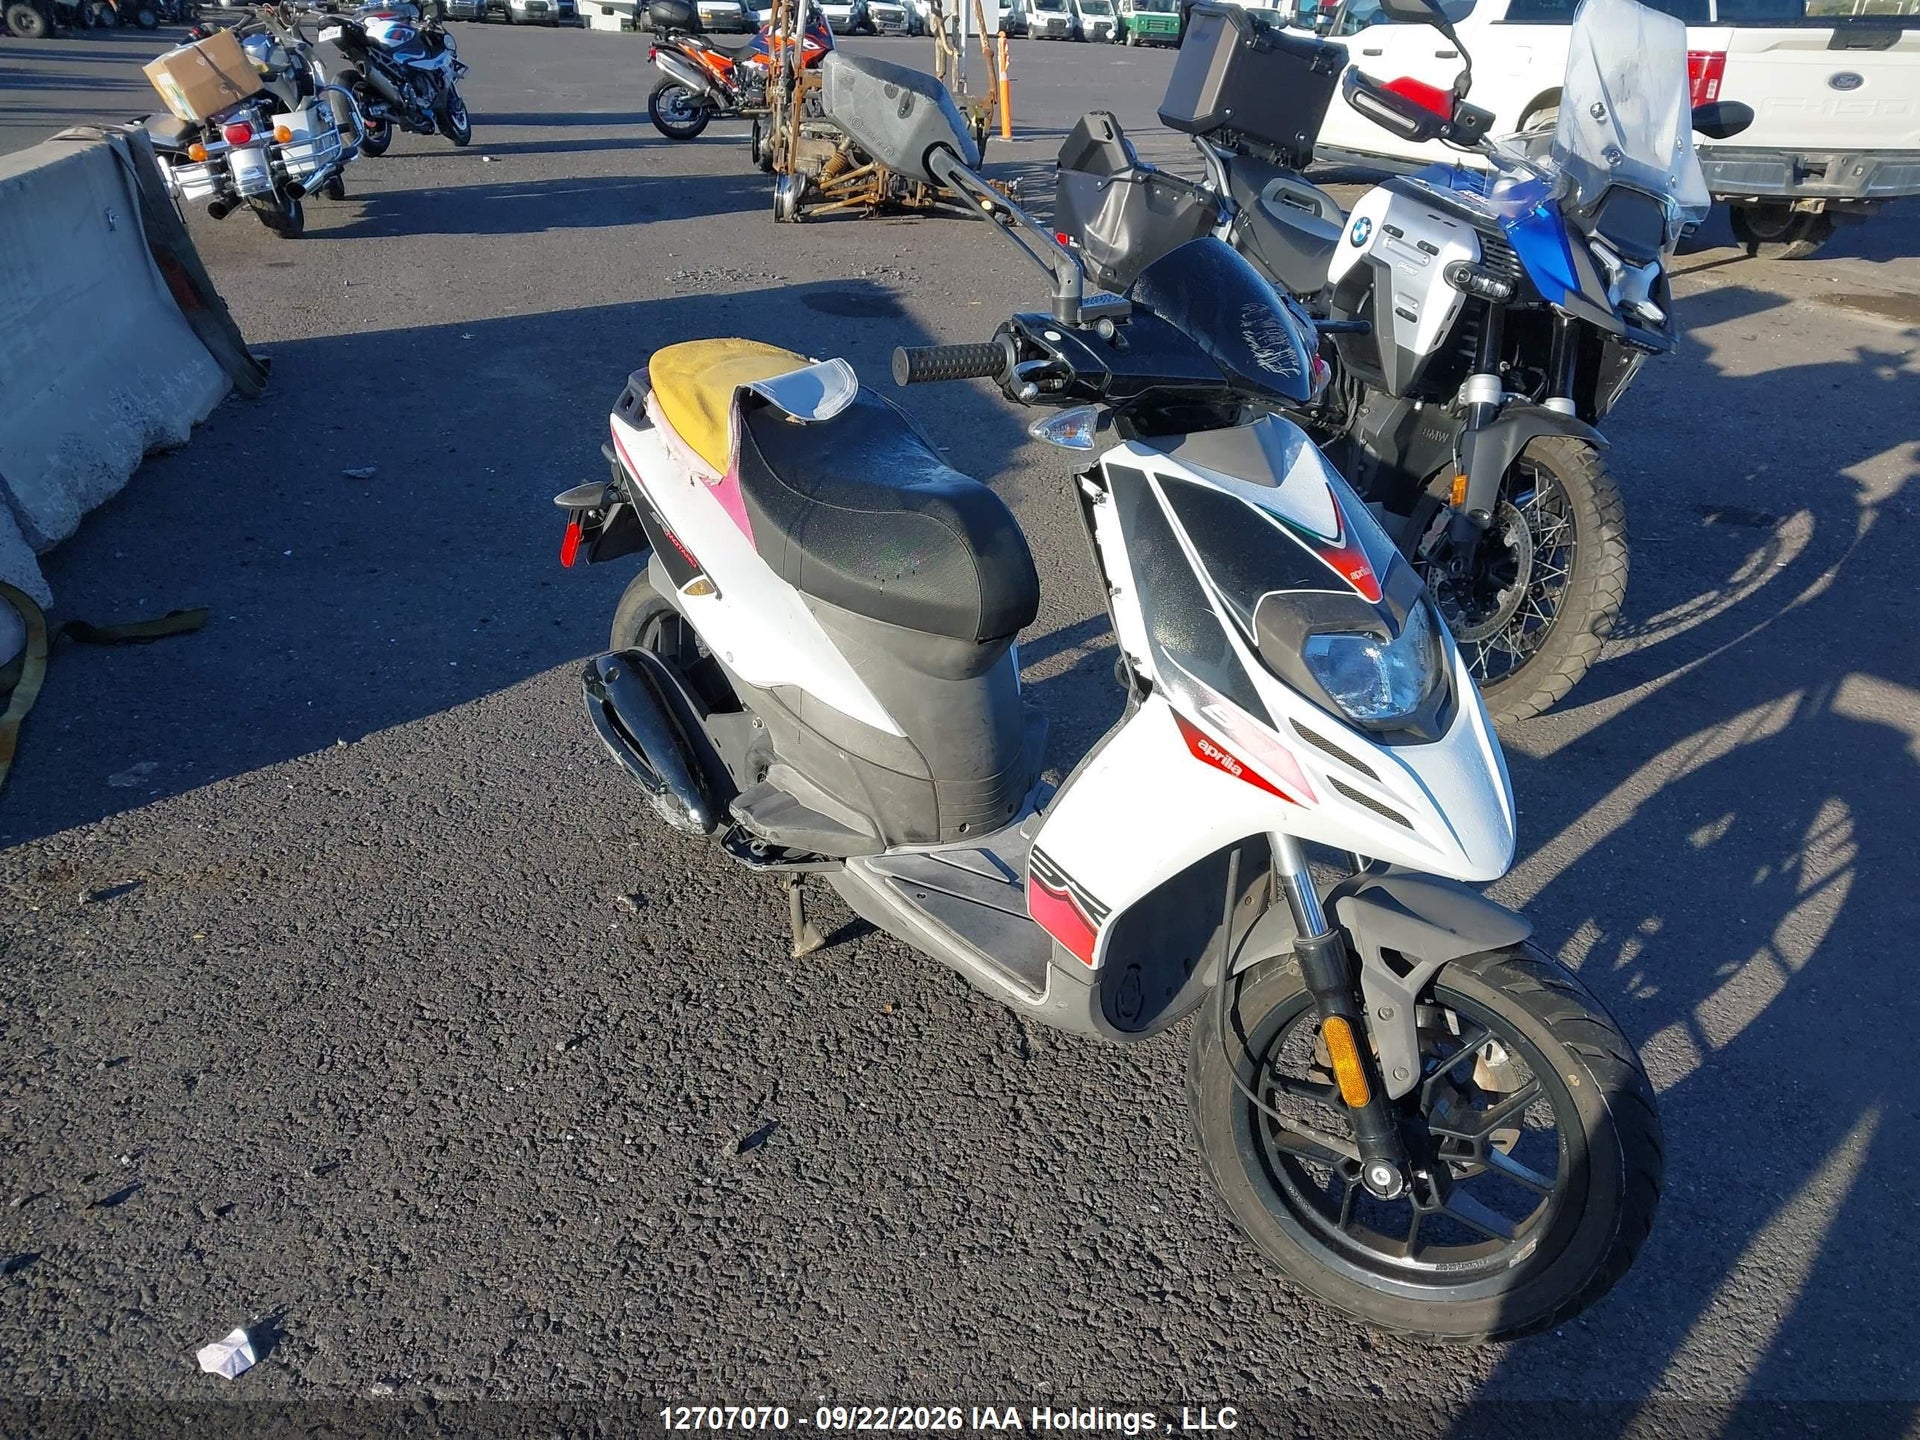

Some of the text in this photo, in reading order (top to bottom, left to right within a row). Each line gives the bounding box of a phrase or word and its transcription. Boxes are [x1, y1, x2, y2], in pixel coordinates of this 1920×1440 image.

[1422, 428, 1450, 443] BMW
[1349, 566, 1372, 580] aprilia
[1197, 738, 1243, 776] aprilia
